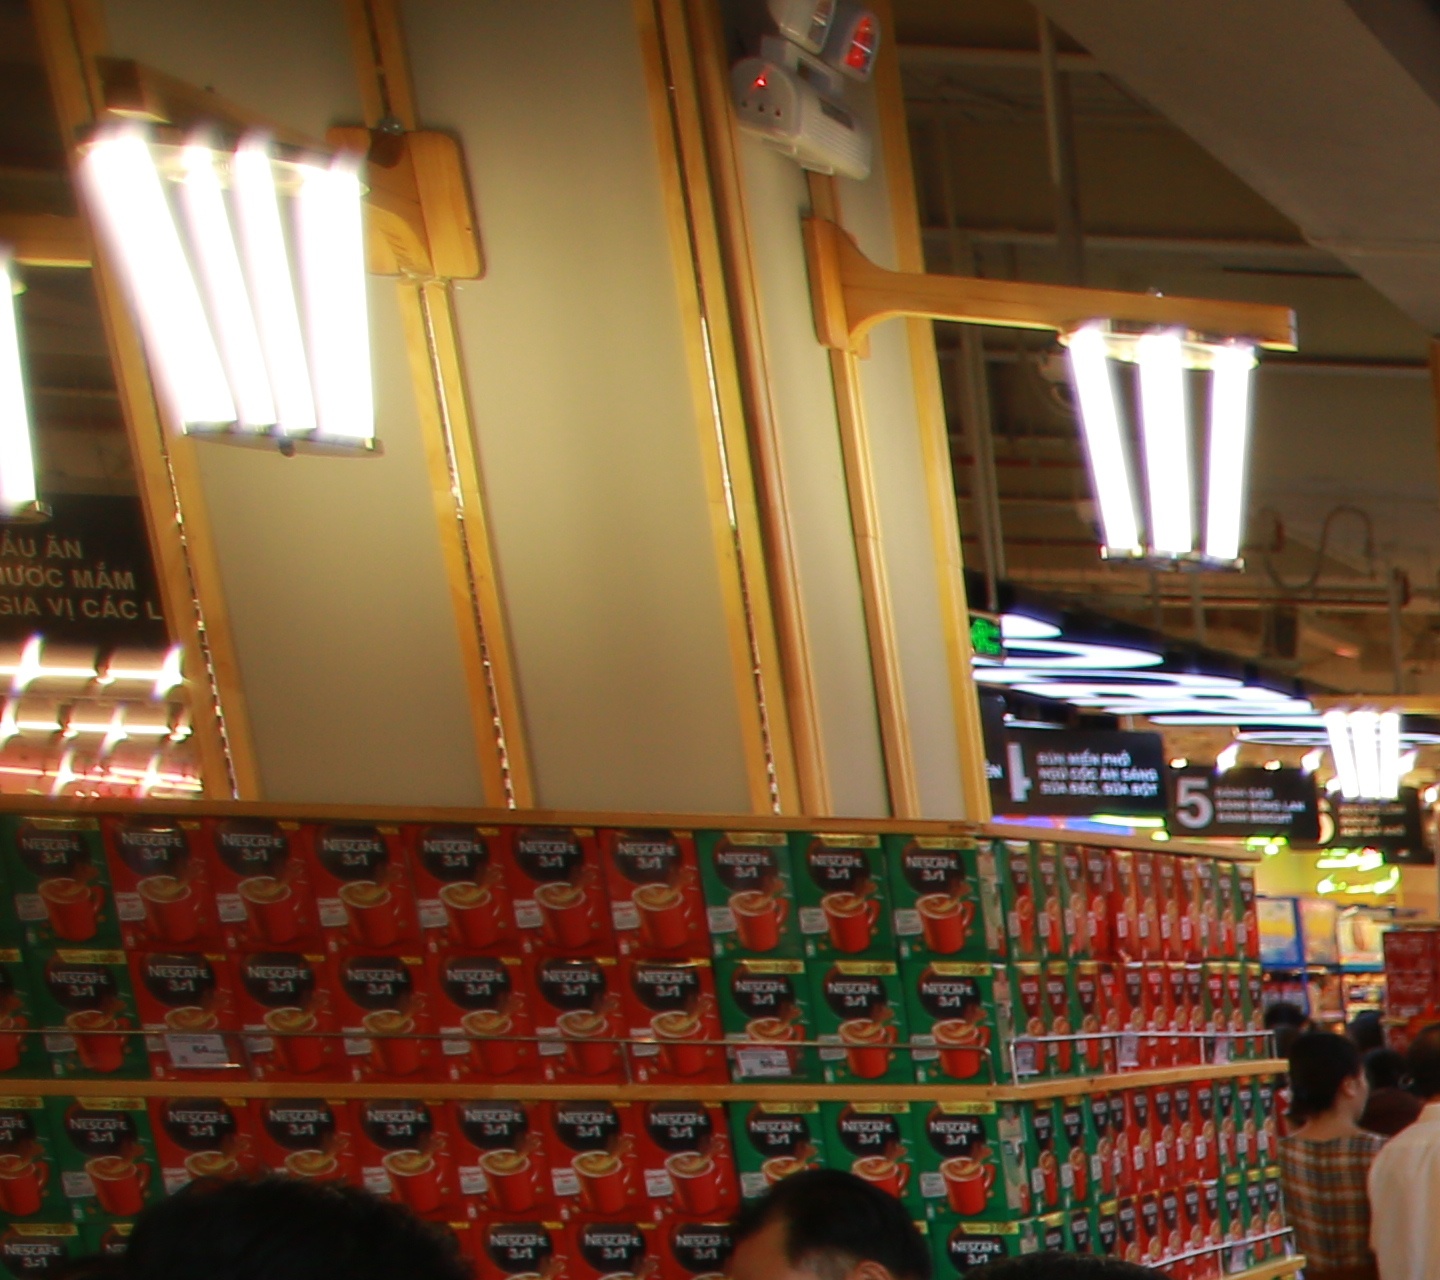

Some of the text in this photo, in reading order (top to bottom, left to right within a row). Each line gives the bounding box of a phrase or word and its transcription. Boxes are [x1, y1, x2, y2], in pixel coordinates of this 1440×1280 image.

[0, 530, 83, 560] ẦU ĂN
[81, 593, 138, 620] CÁC
[1176, 776, 1214, 829] 5
